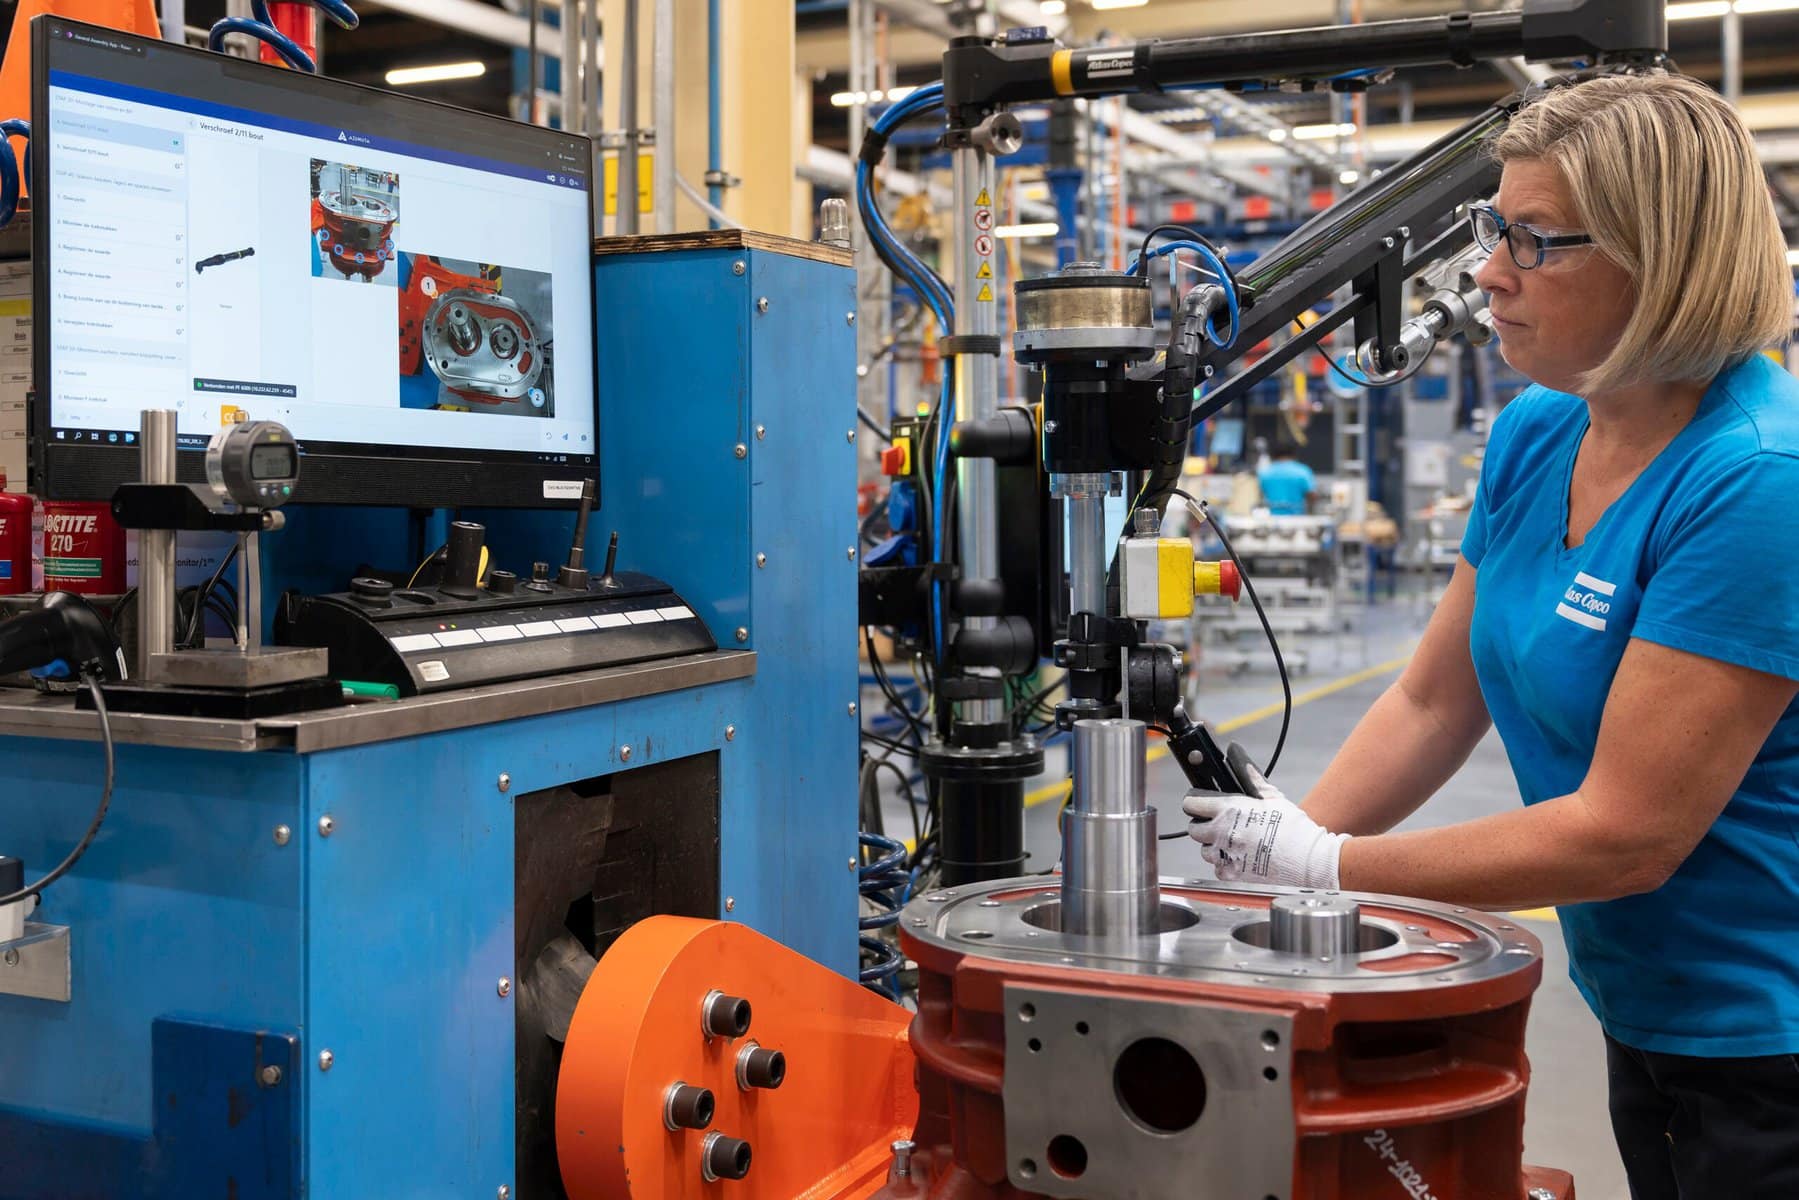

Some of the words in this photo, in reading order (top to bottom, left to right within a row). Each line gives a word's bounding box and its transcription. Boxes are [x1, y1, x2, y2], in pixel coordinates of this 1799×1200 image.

[200, 122, 234, 135] Verschroef
[248, 131, 264, 140] bout
[43, 514, 97, 533] LOCTITE
[51, 534, 73, 552] 270
